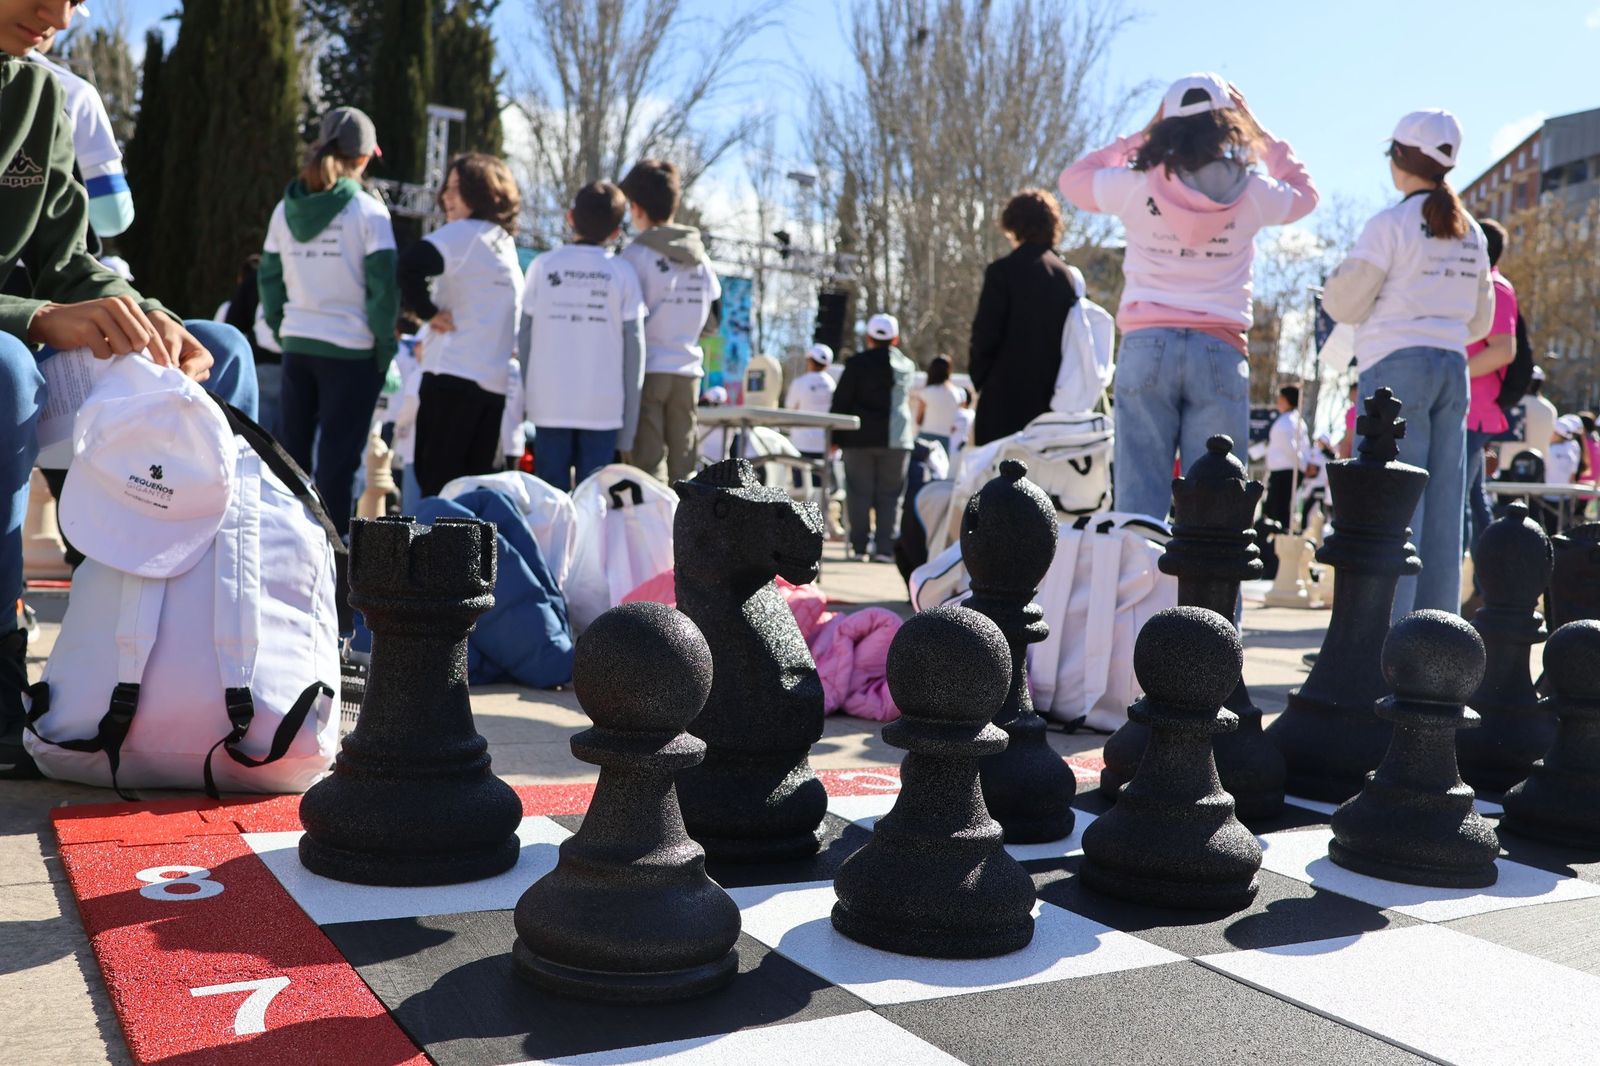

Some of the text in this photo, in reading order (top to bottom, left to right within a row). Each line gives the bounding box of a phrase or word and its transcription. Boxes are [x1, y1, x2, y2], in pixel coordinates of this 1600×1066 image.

[0, 175, 44, 187] appa
[129, 475, 174, 495] PEQUEÑOS
[135, 865, 225, 901] 8
[189, 976, 291, 1036] 7
